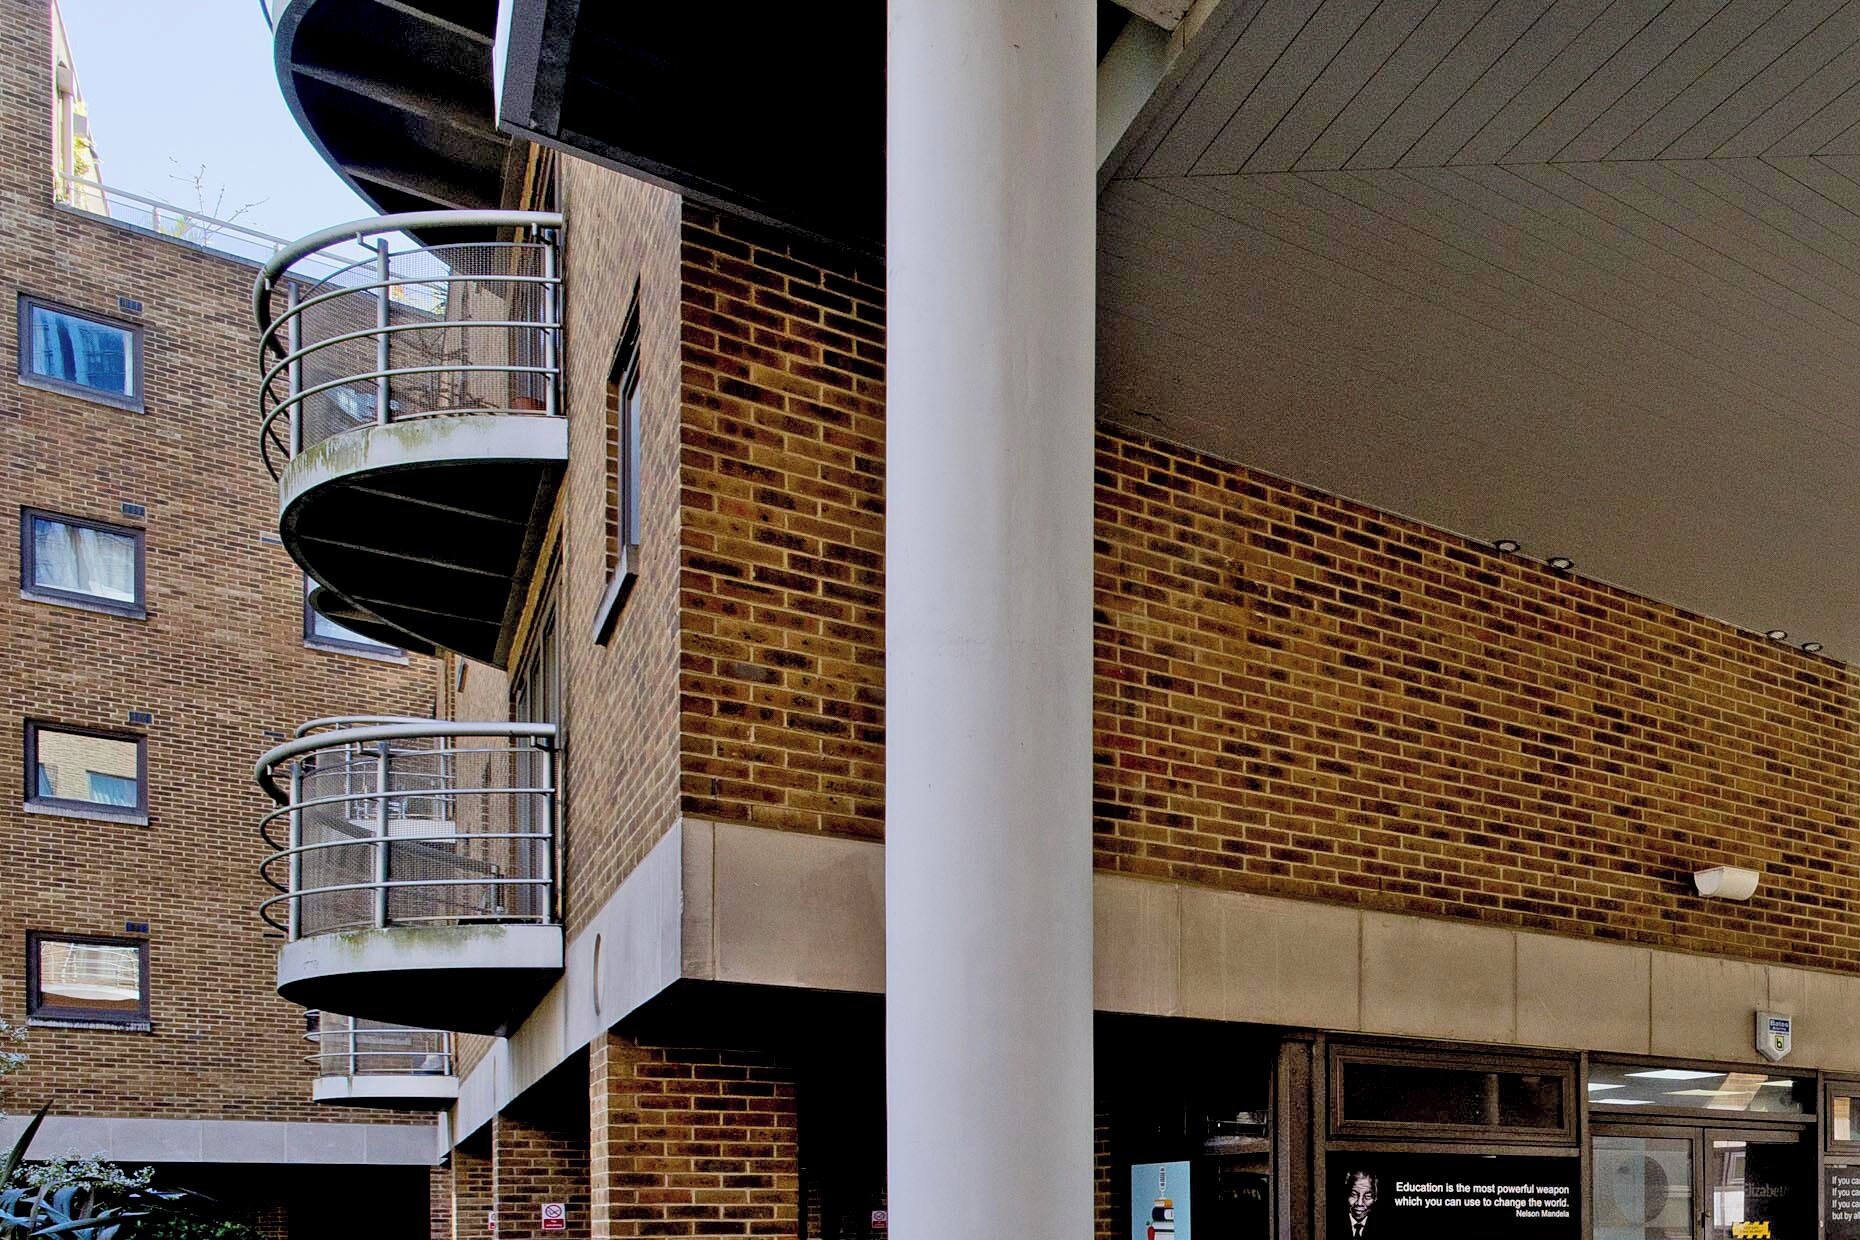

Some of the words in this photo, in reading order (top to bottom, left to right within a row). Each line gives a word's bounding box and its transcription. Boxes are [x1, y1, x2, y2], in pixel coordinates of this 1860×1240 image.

[1832, 1176, 1837, 1184] If
[1838, 1178, 1850, 1186] you
[1396, 1182, 1443, 1192] Education
[1446, 1183, 1454, 1192] is
[1456, 1183, 1470, 1193] the
[1473, 1184, 1495, 1193] most
[1497, 1184, 1534, 1195] powerful
[1536, 1186, 1569, 1195] weapon
[1832, 1188, 1837, 1196] If
[1838, 1189, 1850, 1198] you
[1395, 1196, 1422, 1206] which
[1425, 1199, 1442, 1208] you
[1483, 1198, 1492, 1207] to
[1494, 1197, 1526, 1209] change
[1528, 1198, 1542, 1207] the
[1544, 1198, 1569, 1207] world.
[1832, 1200, 1837, 1208] If
[1838, 1201, 1850, 1209] you
[1541, 1210, 1570, 1218] Mandela
[1832, 1212, 1843, 1220] but
[1844, 1213, 1852, 1221] by
